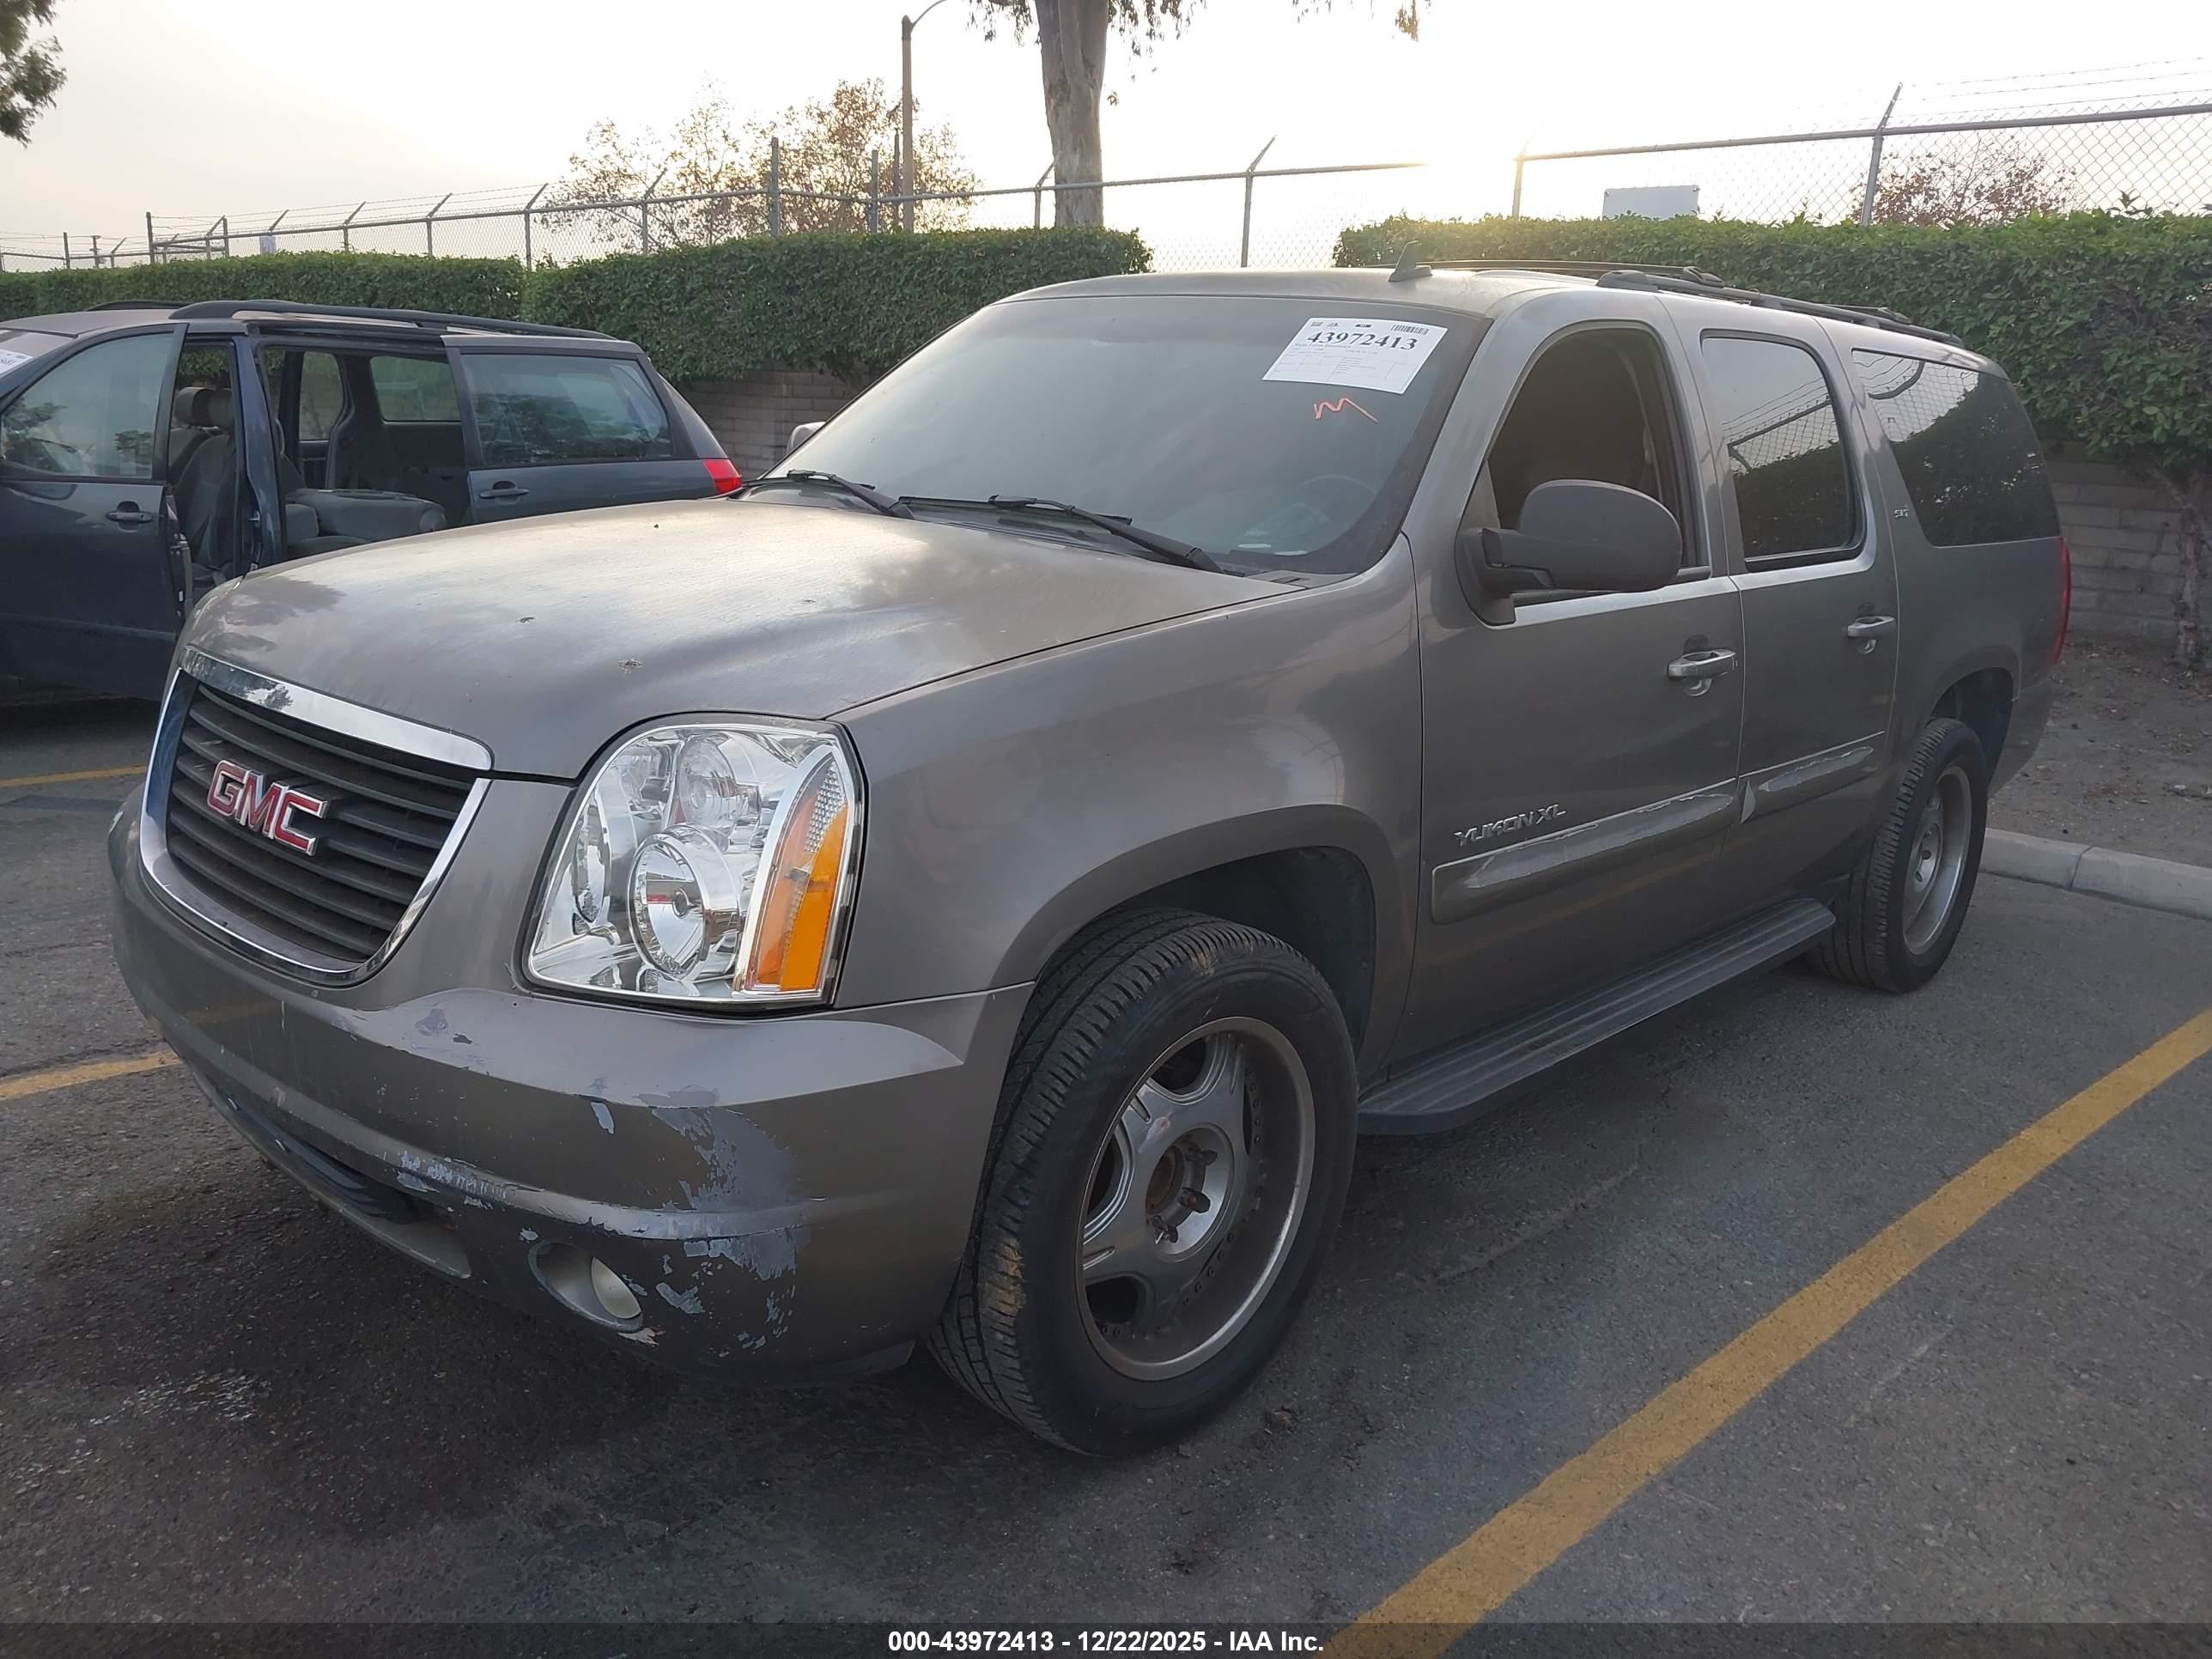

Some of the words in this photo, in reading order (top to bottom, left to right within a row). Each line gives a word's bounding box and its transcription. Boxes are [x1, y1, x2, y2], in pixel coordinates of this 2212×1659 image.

[1307, 331, 1418, 350] 43972413
[207, 759, 330, 857] GMC
[1453, 811, 1534, 848] YUKON
[1535, 804, 1567, 825] XL
